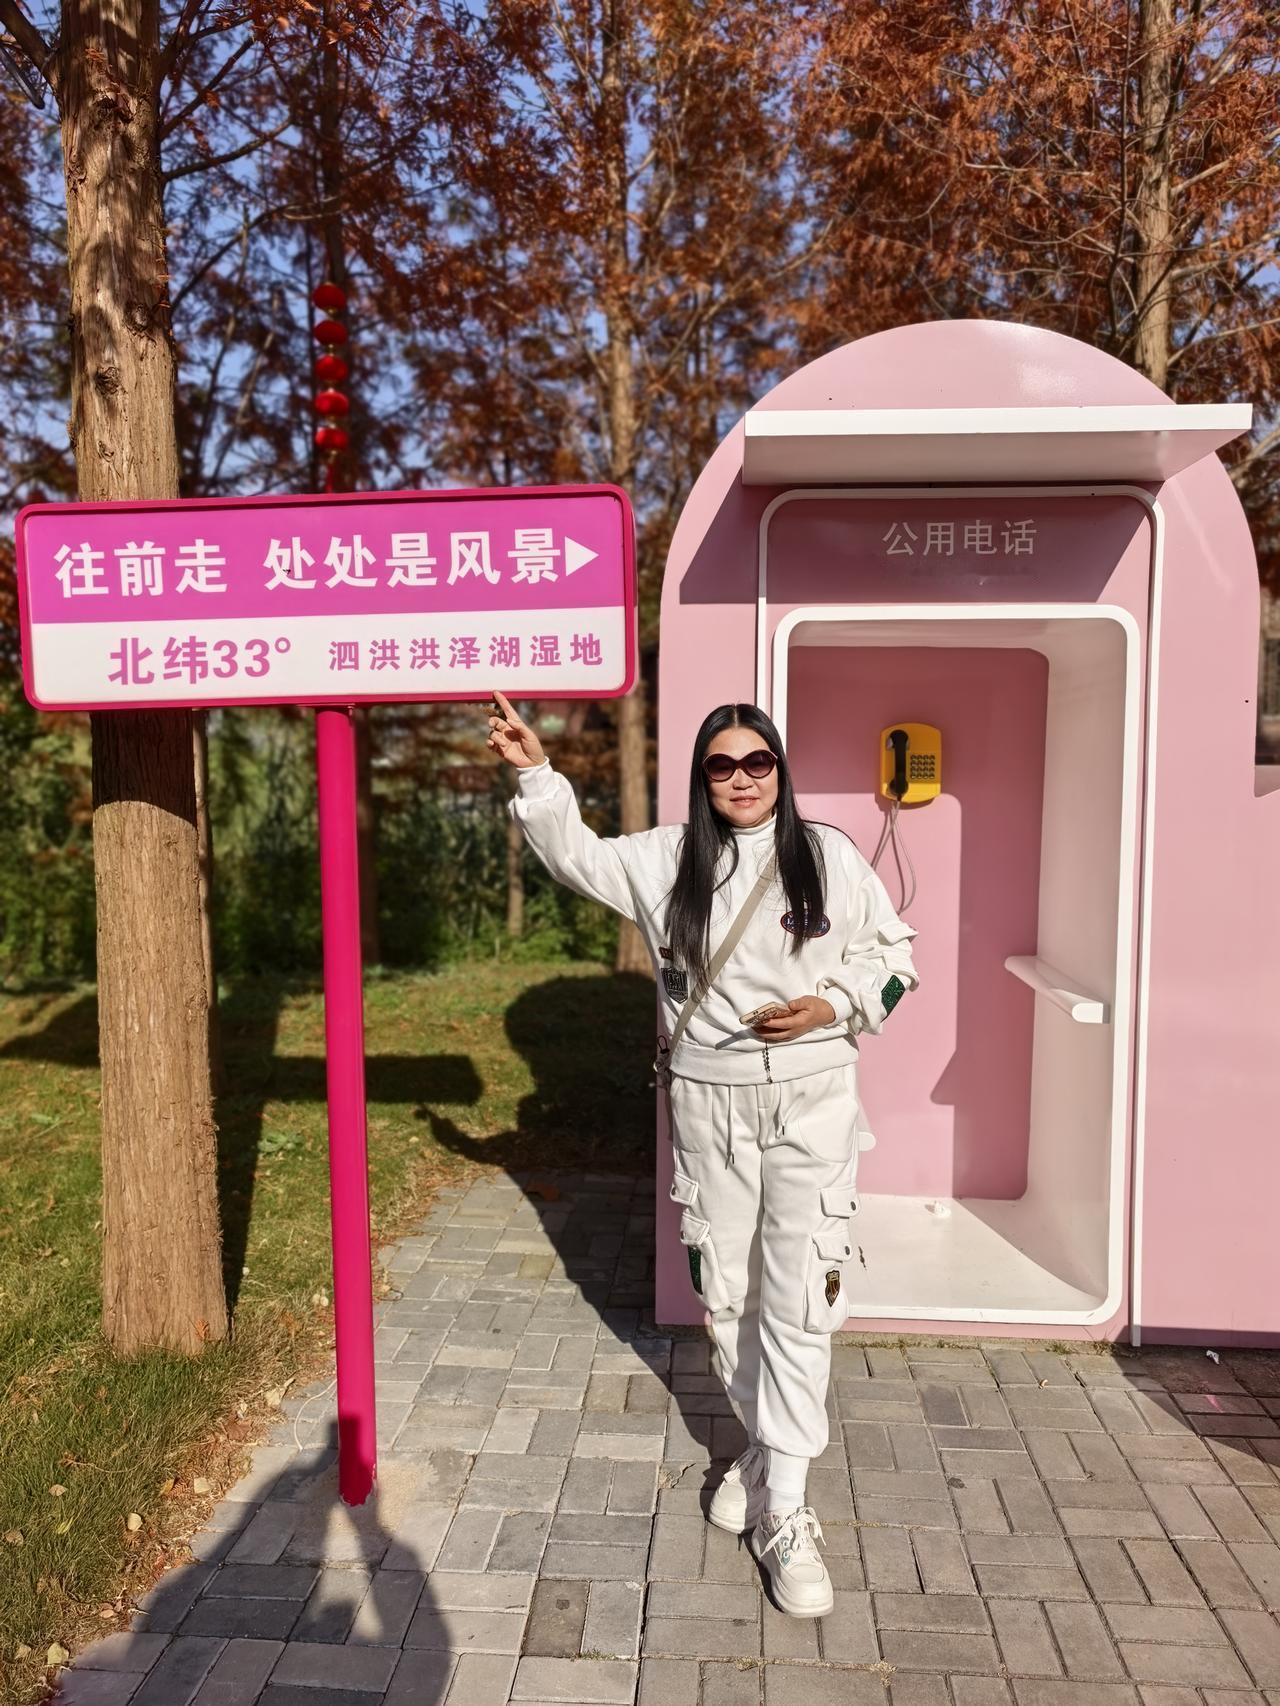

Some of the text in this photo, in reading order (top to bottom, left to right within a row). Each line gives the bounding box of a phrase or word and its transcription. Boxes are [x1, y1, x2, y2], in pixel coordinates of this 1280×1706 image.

[54, 528, 562, 598] 往前走 处处是风景
[882, 519, 1037, 556] 公用电话
[108, 633, 604, 686] 北纬33° 泗洪洪泽湖湿地
